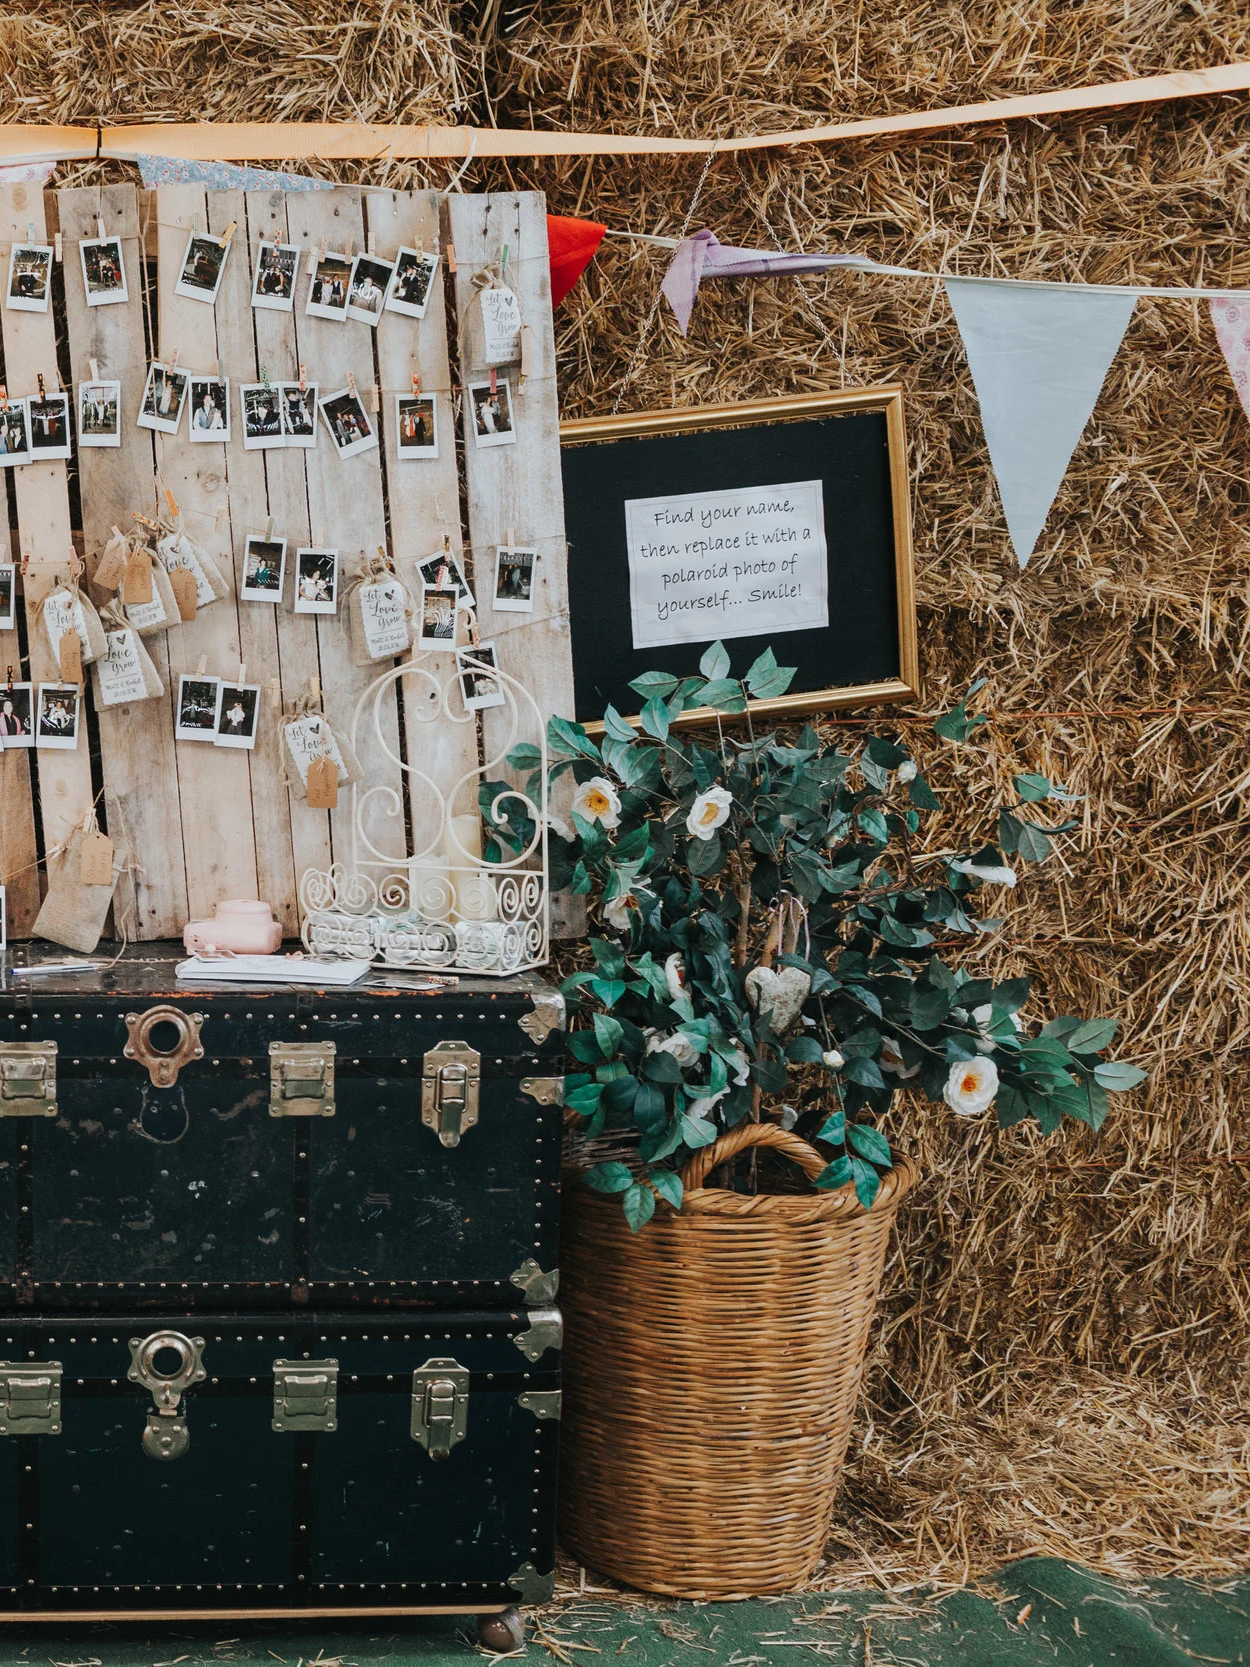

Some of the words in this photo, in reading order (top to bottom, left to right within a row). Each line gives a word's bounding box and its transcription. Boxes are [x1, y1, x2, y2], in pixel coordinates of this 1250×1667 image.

[486, 292, 501, 306] Let
[490, 306, 516, 322] Love
[497, 322, 518, 336] Grow
[654, 508, 694, 526] Find
[700, 505, 741, 528] your
[746, 499, 795, 515] name,
[640, 544, 680, 558] then
[685, 535, 740, 558] replace
[745, 531, 758, 546] it
[763, 527, 797, 544] with
[802, 528, 811, 539] a
[662, 563, 728, 590] polaroid
[733, 560, 776, 583] photo
[781, 553, 799, 574] of
[364, 589, 381, 602] Let
[657, 590, 742, 620] yourself...
[747, 583, 802, 602] Smile!
[369, 600, 398, 617] Love
[378, 615, 401, 629] Grow
[104, 645, 132, 663] Love
[111, 660, 136, 676] Grow
[289, 725, 306, 741] Let
